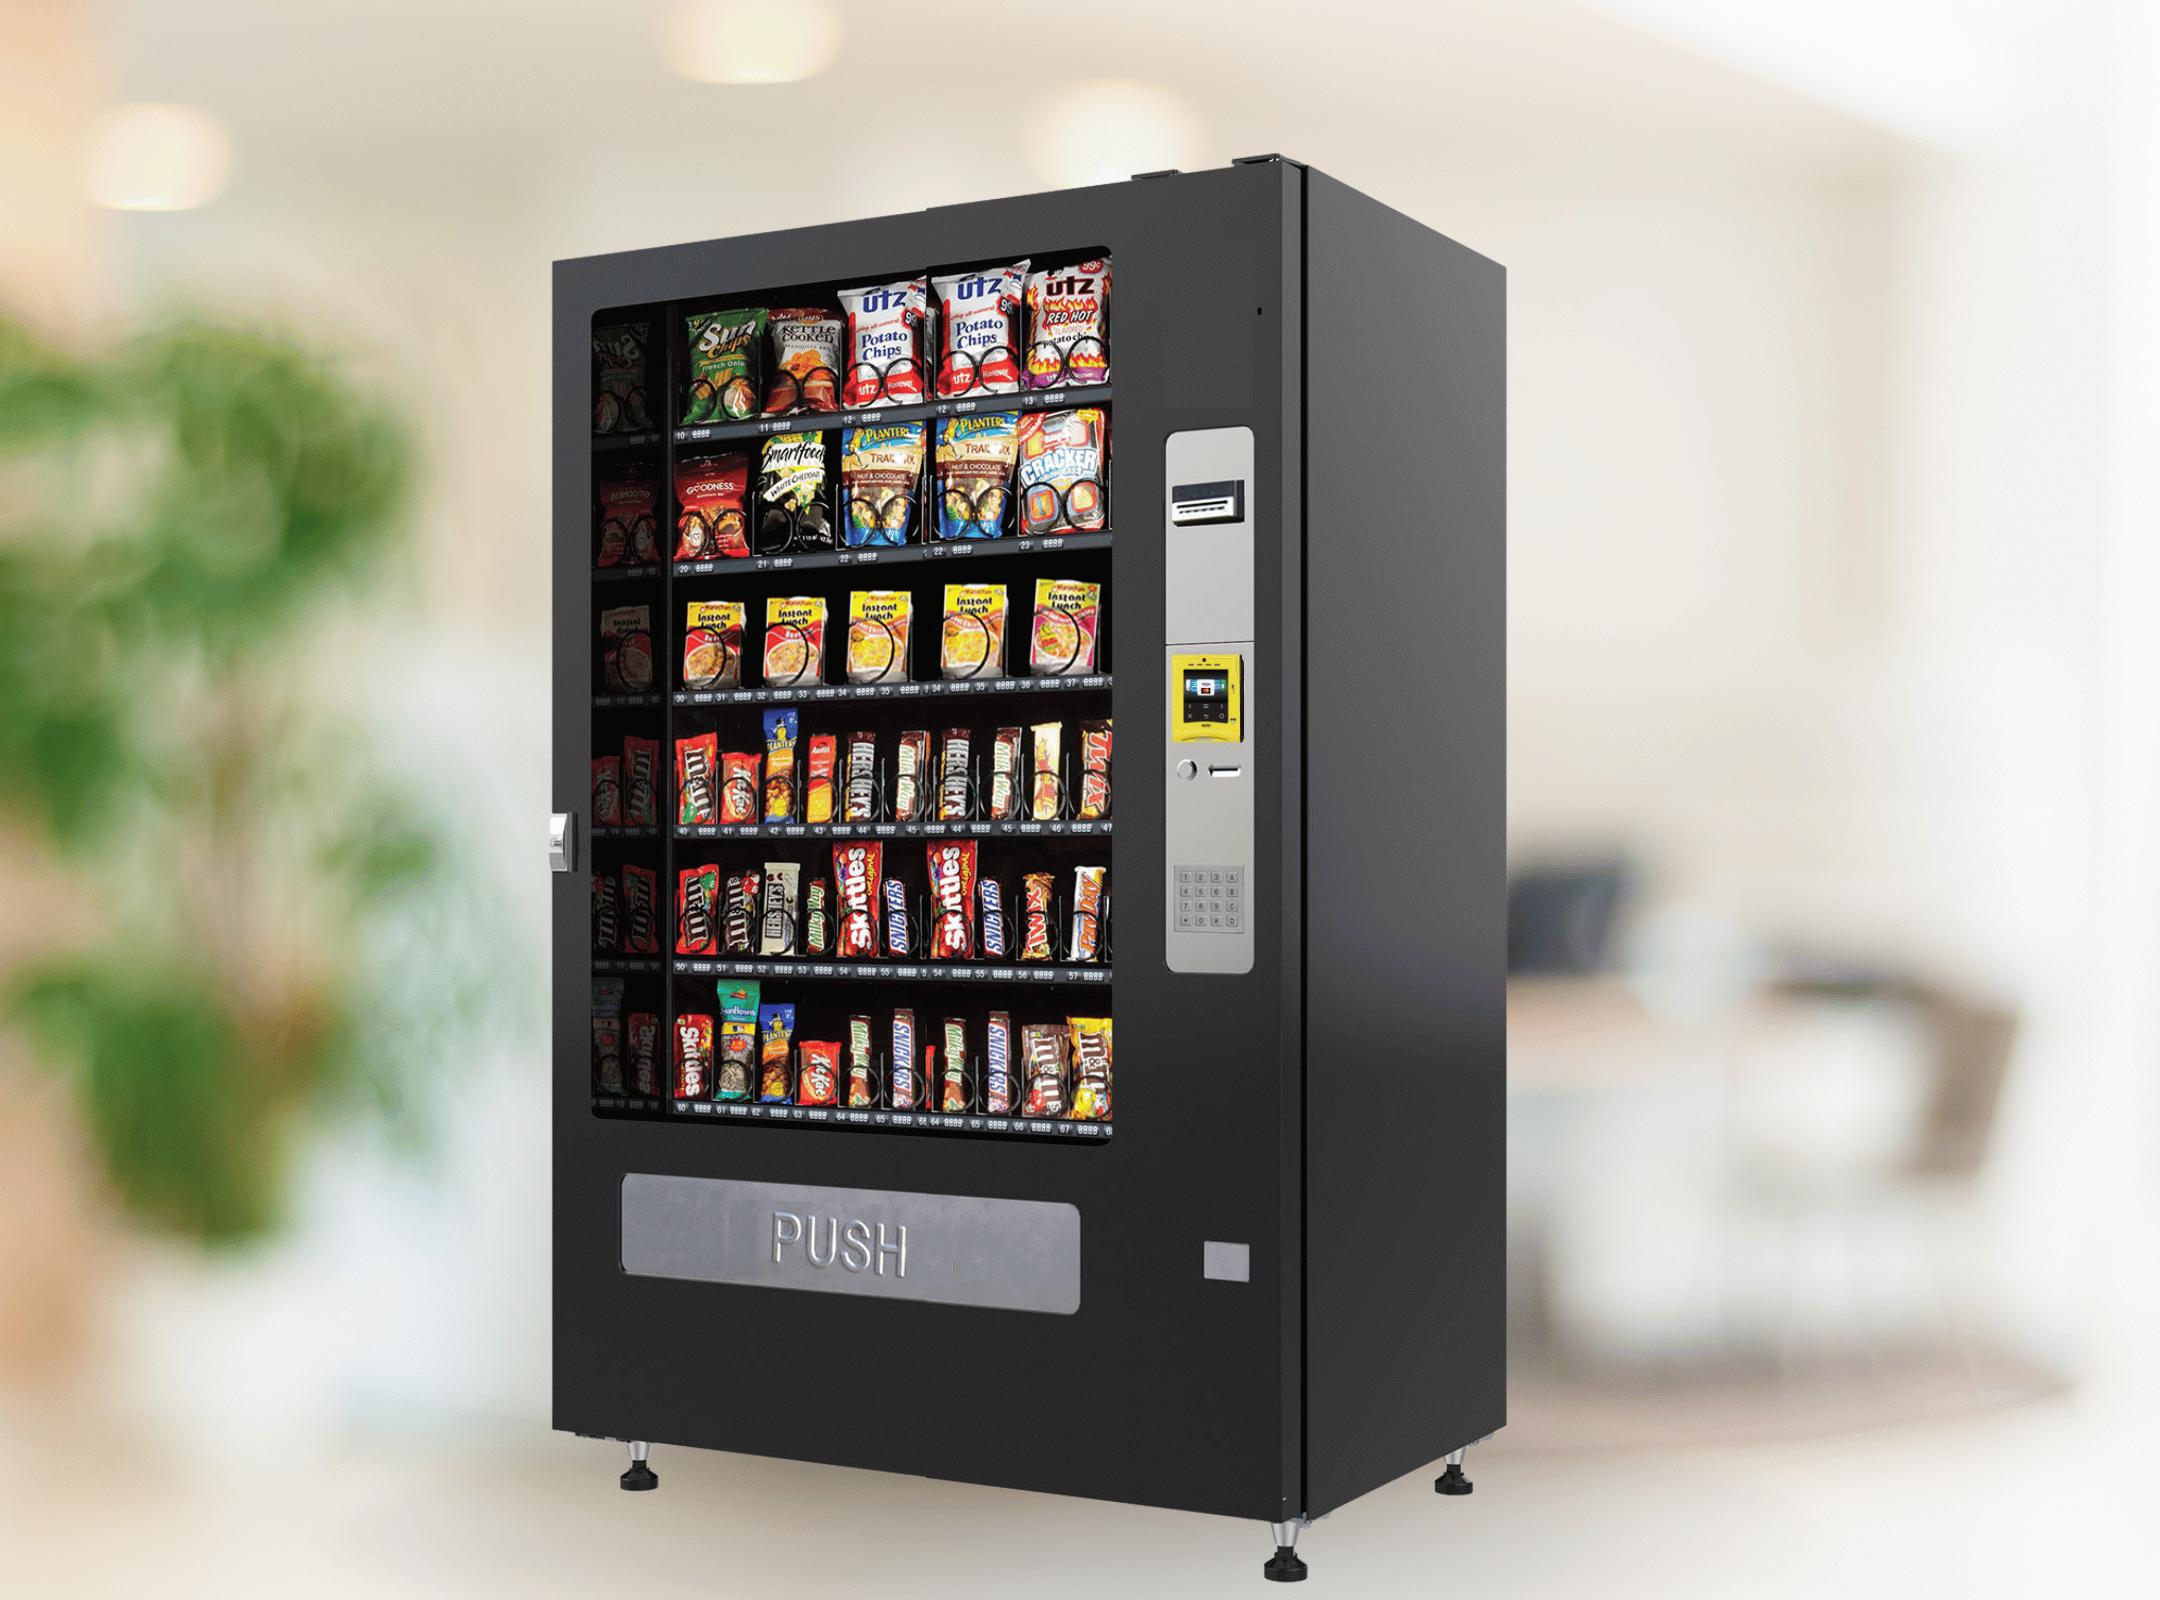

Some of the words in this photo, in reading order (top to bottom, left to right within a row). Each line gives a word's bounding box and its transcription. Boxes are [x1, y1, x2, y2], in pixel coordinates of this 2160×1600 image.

[1047, 312, 1069, 325] RED
[1071, 310, 1093, 323] HOT
[698, 320, 757, 352] Sun
[956, 319, 1003, 337] Potato
[862, 331, 908, 349] Potato
[957, 333, 998, 350] Chips
[862, 346, 902, 361] Chips
[727, 360, 746, 368] Onio
[760, 423, 768, 432] 11
[844, 416, 853, 424] 12
[939, 405, 947, 413] 12
[1025, 396, 1033, 405] 13
[1020, 448, 1098, 488] CRACKER
[770, 480, 791, 497] WHITE
[679, 564, 689, 573] 20
[757, 560, 767, 569] 21
[840, 555, 849, 563] 22
[934, 547, 943, 556] 22
[957, 597, 992, 606] Instant
[1048, 592, 1086, 602] Instant
[778, 609, 812, 618] Instant
[862, 603, 897, 612] Instant
[698, 613, 731, 622] Instant
[771, 1211, 907, 1279] PUSH
